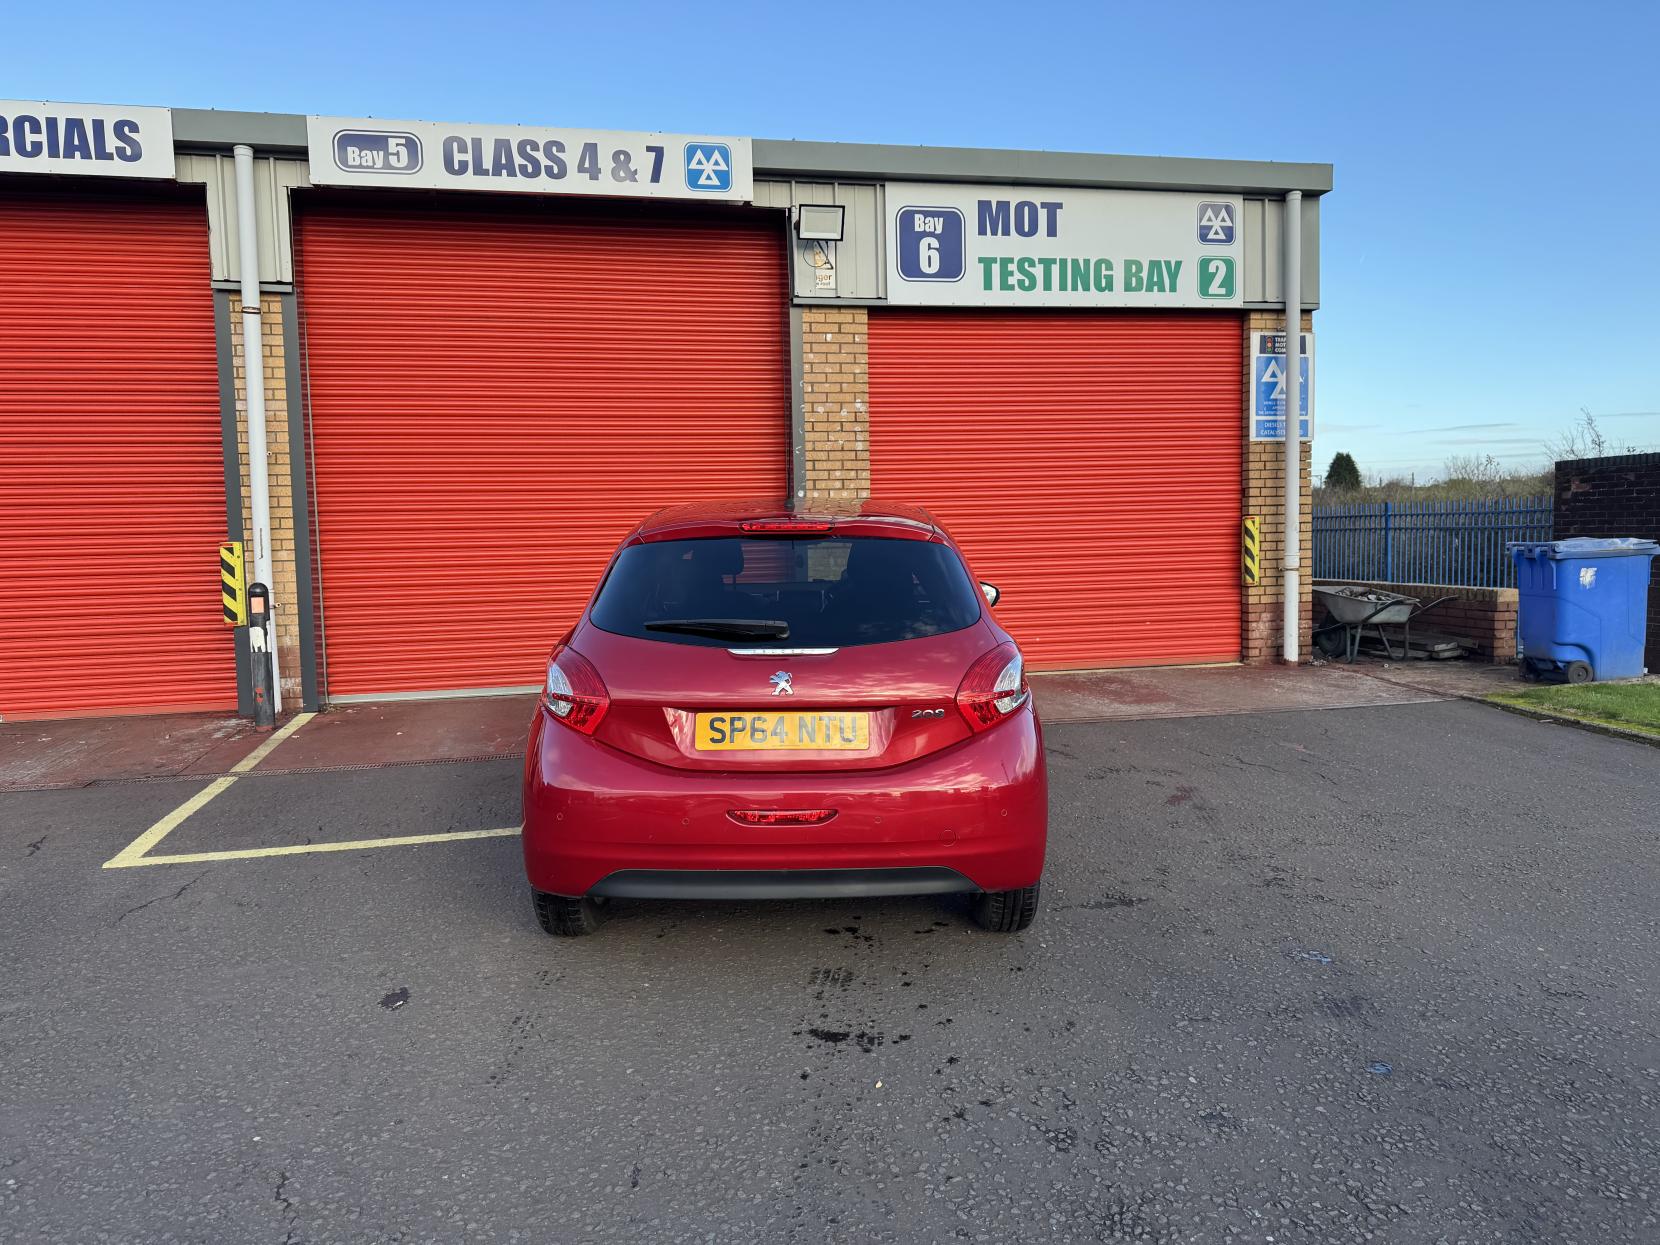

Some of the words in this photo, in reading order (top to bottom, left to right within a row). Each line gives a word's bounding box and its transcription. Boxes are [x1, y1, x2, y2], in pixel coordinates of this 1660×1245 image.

[347, 146, 384, 168] Bay
[388, 137, 409, 168] 5
[443, 136, 568, 180] CLASS
[577, 142, 602, 181] 4
[611, 149, 638, 183] &
[646, 145, 665, 184] 7
[914, 213, 944, 234] Bay
[977, 200, 1063, 238] MOT
[919, 236, 940, 274] 6
[978, 256, 1114, 293] TESTING
[1123, 258, 1183, 293] BAY
[1208, 259, 1227, 295] 2
[709, 716, 788, 744] SP64
[798, 715, 857, 743] NTU
[911, 708, 945, 718] 208
